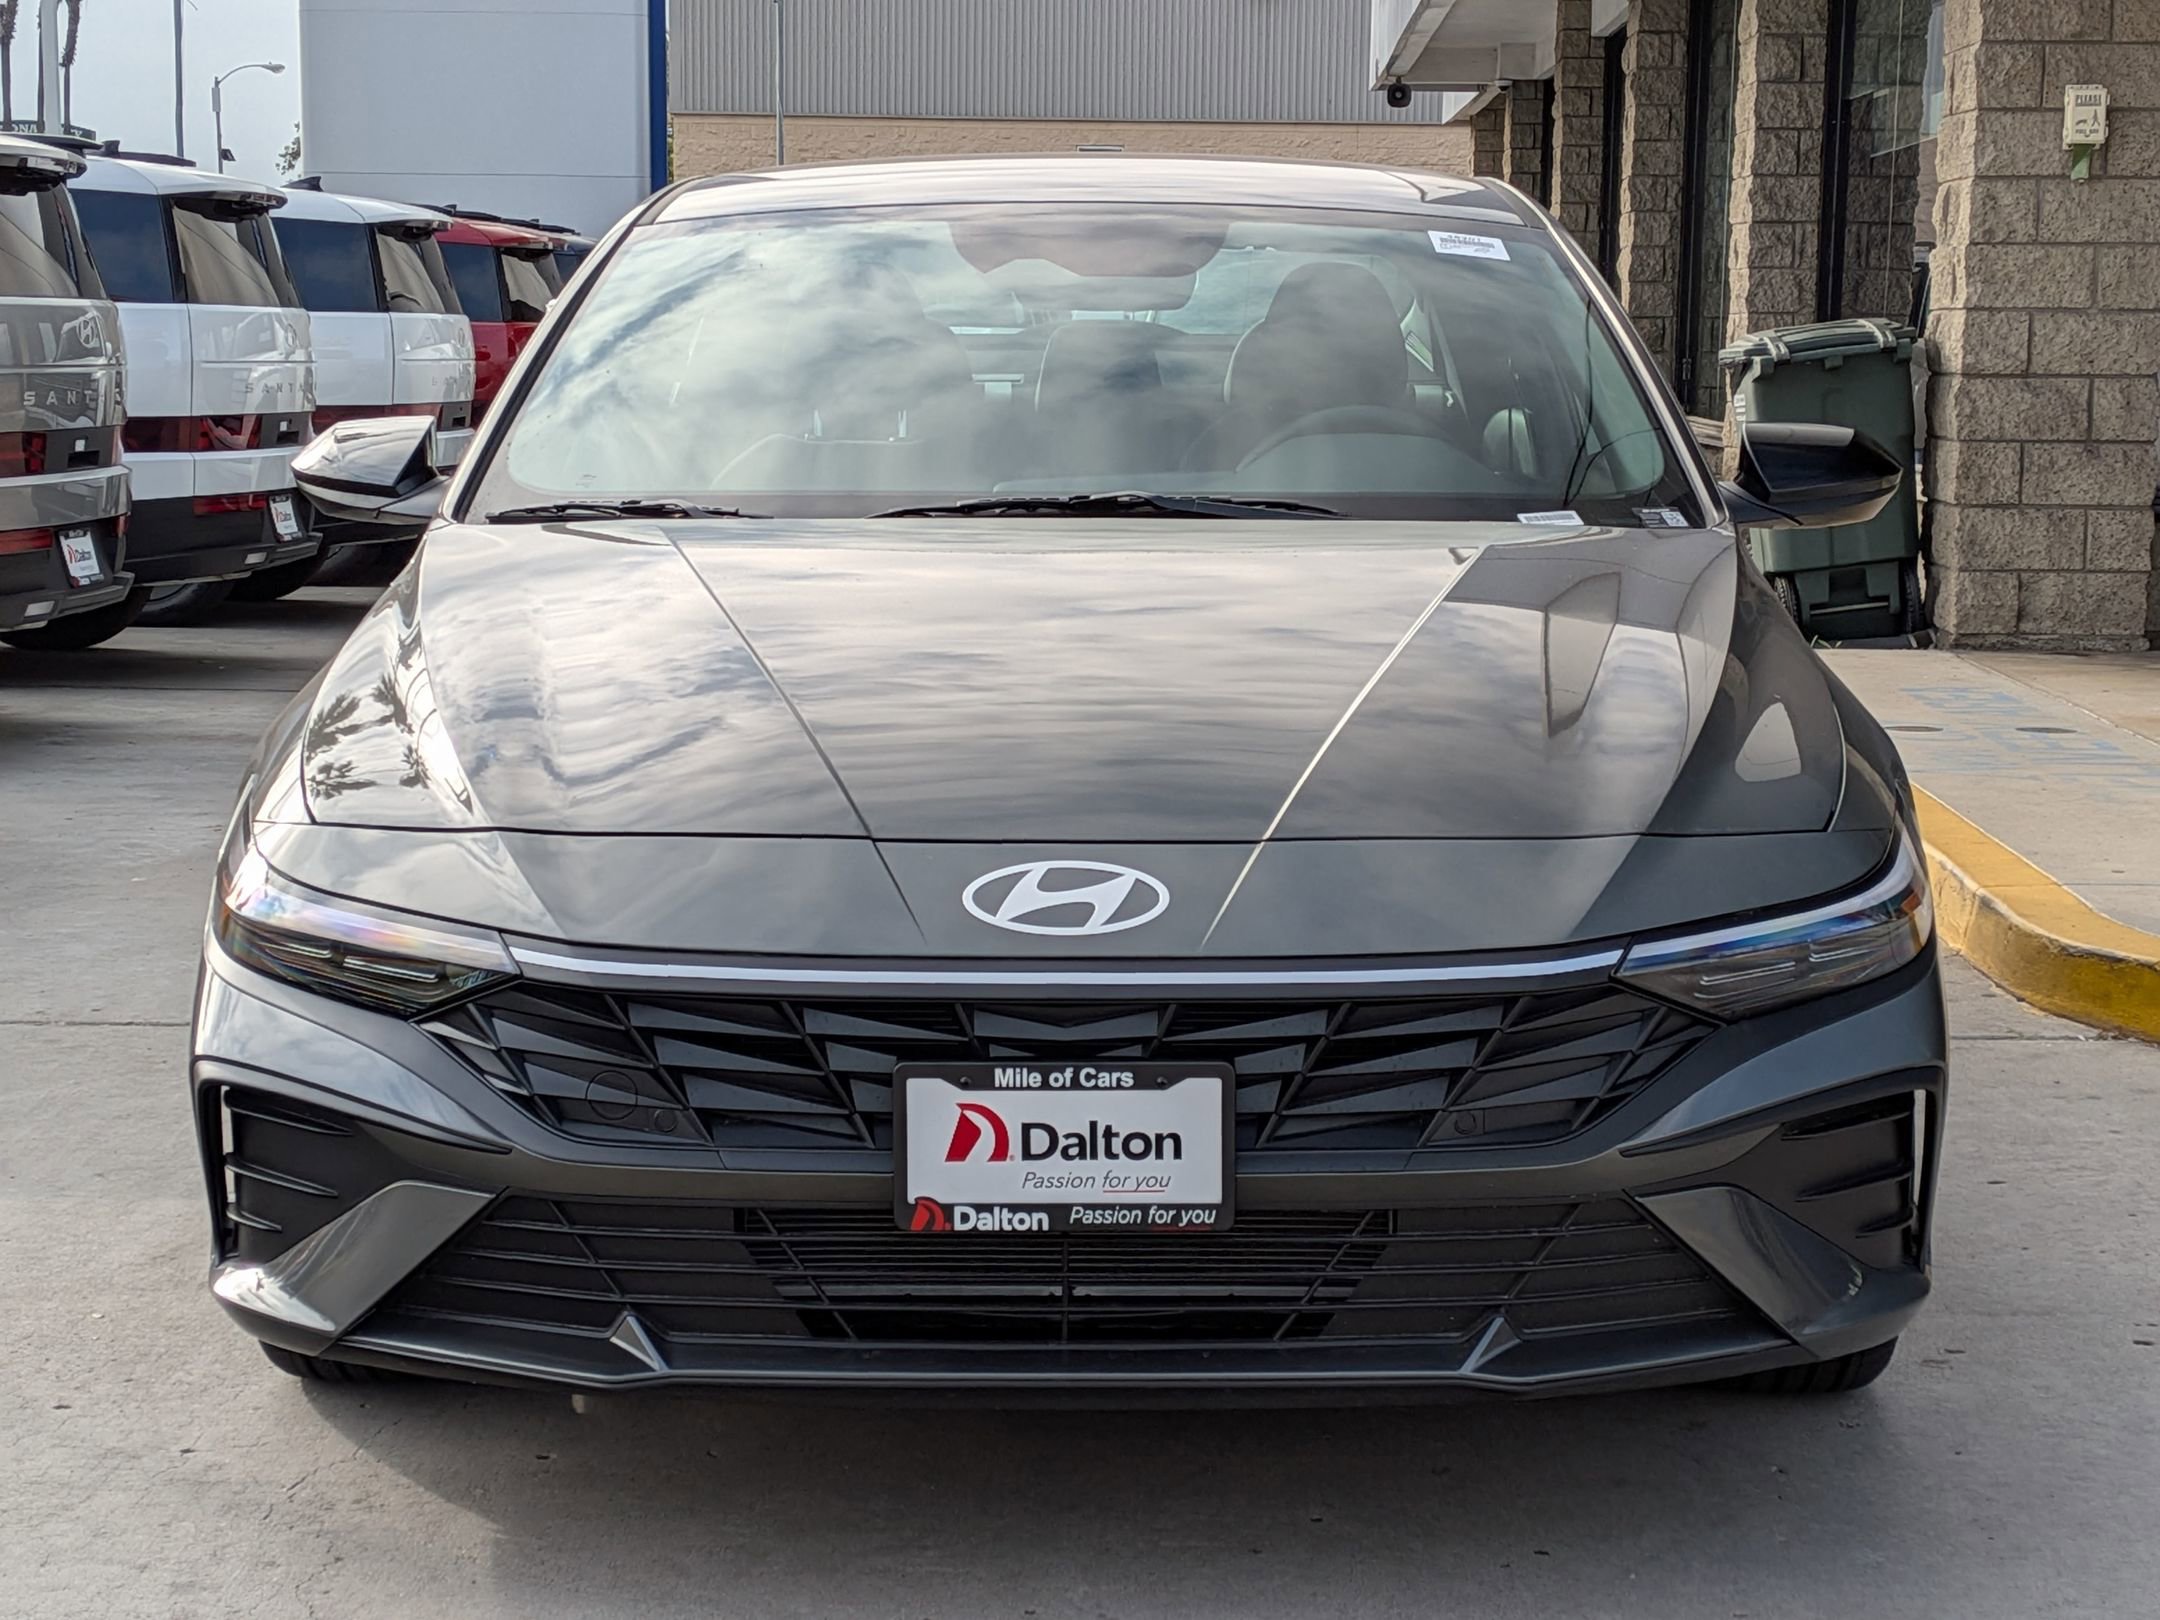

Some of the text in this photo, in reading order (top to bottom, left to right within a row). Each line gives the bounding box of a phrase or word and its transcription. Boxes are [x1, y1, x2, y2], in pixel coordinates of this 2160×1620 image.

[994, 1067, 1135, 1088] Mile of Cars
[1021, 1120, 1183, 1161] Dalton
[1022, 1170, 1172, 1192] Passion for you
[953, 1205, 1050, 1232] Dalton
[1069, 1205, 1217, 1227] Passion for you
